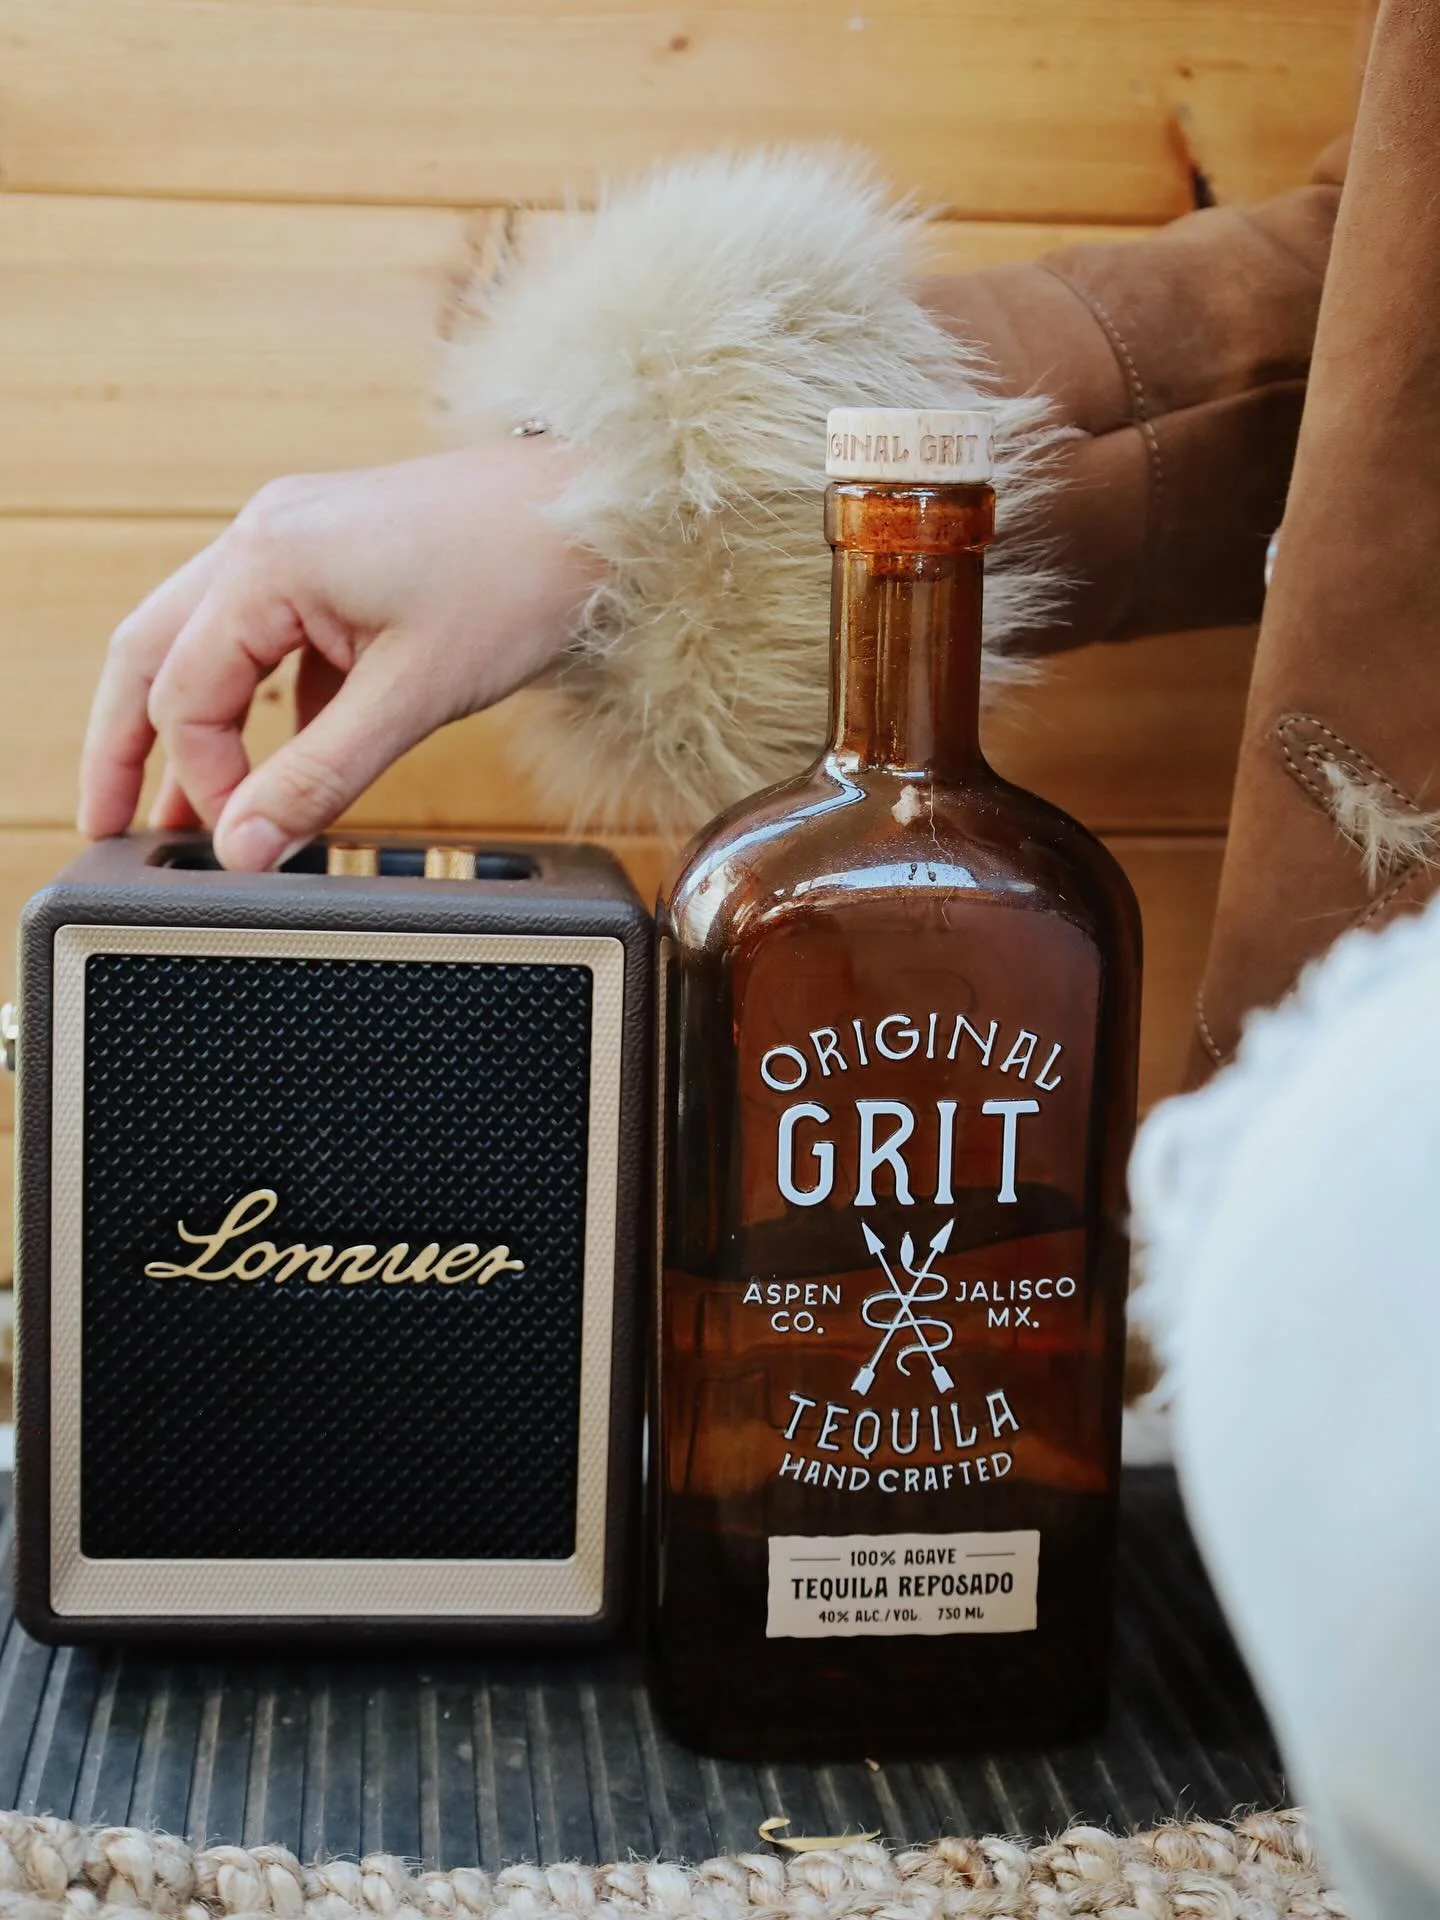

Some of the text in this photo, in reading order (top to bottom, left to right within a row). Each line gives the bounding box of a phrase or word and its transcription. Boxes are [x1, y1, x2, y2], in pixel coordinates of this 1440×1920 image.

[919, 434, 978, 464] GRIT
[760, 1012, 1063, 1092] ORIGINAL
[777, 1099, 1040, 1207] GRIT
[742, 1283, 841, 1305] ASPEN
[955, 1276, 1076, 1302] JALISCO
[770, 1310, 824, 1334] CO.
[988, 1306, 1040, 1328] MX.
[783, 1391, 1020, 1460] TEQUILA
[850, 1548, 957, 1567] 100% AGAVE
[791, 1571, 1014, 1602] TEQUILA REPOSADO
[818, 1610, 849, 1623] 40%
[964, 1606, 985, 1620] ML
